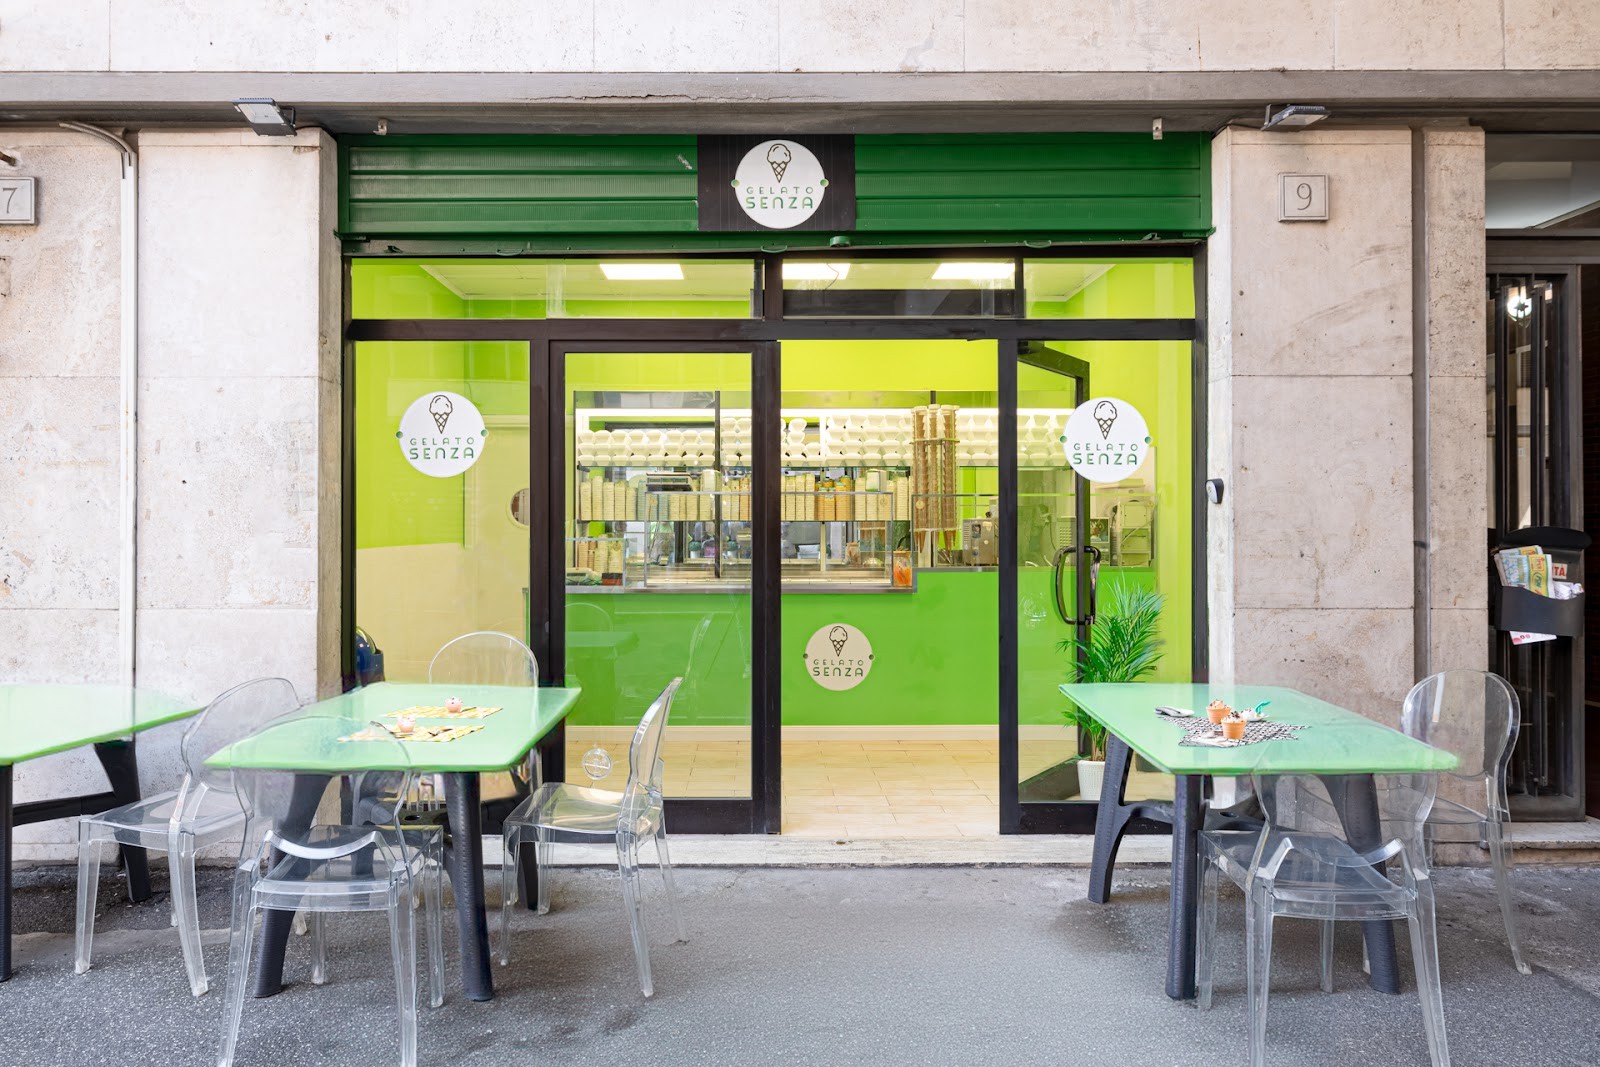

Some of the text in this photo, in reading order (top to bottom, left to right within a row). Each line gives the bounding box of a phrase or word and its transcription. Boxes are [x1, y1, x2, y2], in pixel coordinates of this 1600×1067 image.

[746, 186, 814, 195] GELATO
[1297, 182, 1312, 211] 9
[2, 187, 18, 214] 7
[745, 196, 814, 209] SENZA
[409, 437, 475, 446] GELATO
[1073, 443, 1139, 451] GELATO
[409, 447, 474, 460] SENZA
[1072, 453, 1138, 465] SENZA
[812, 666, 864, 677] SENZA
